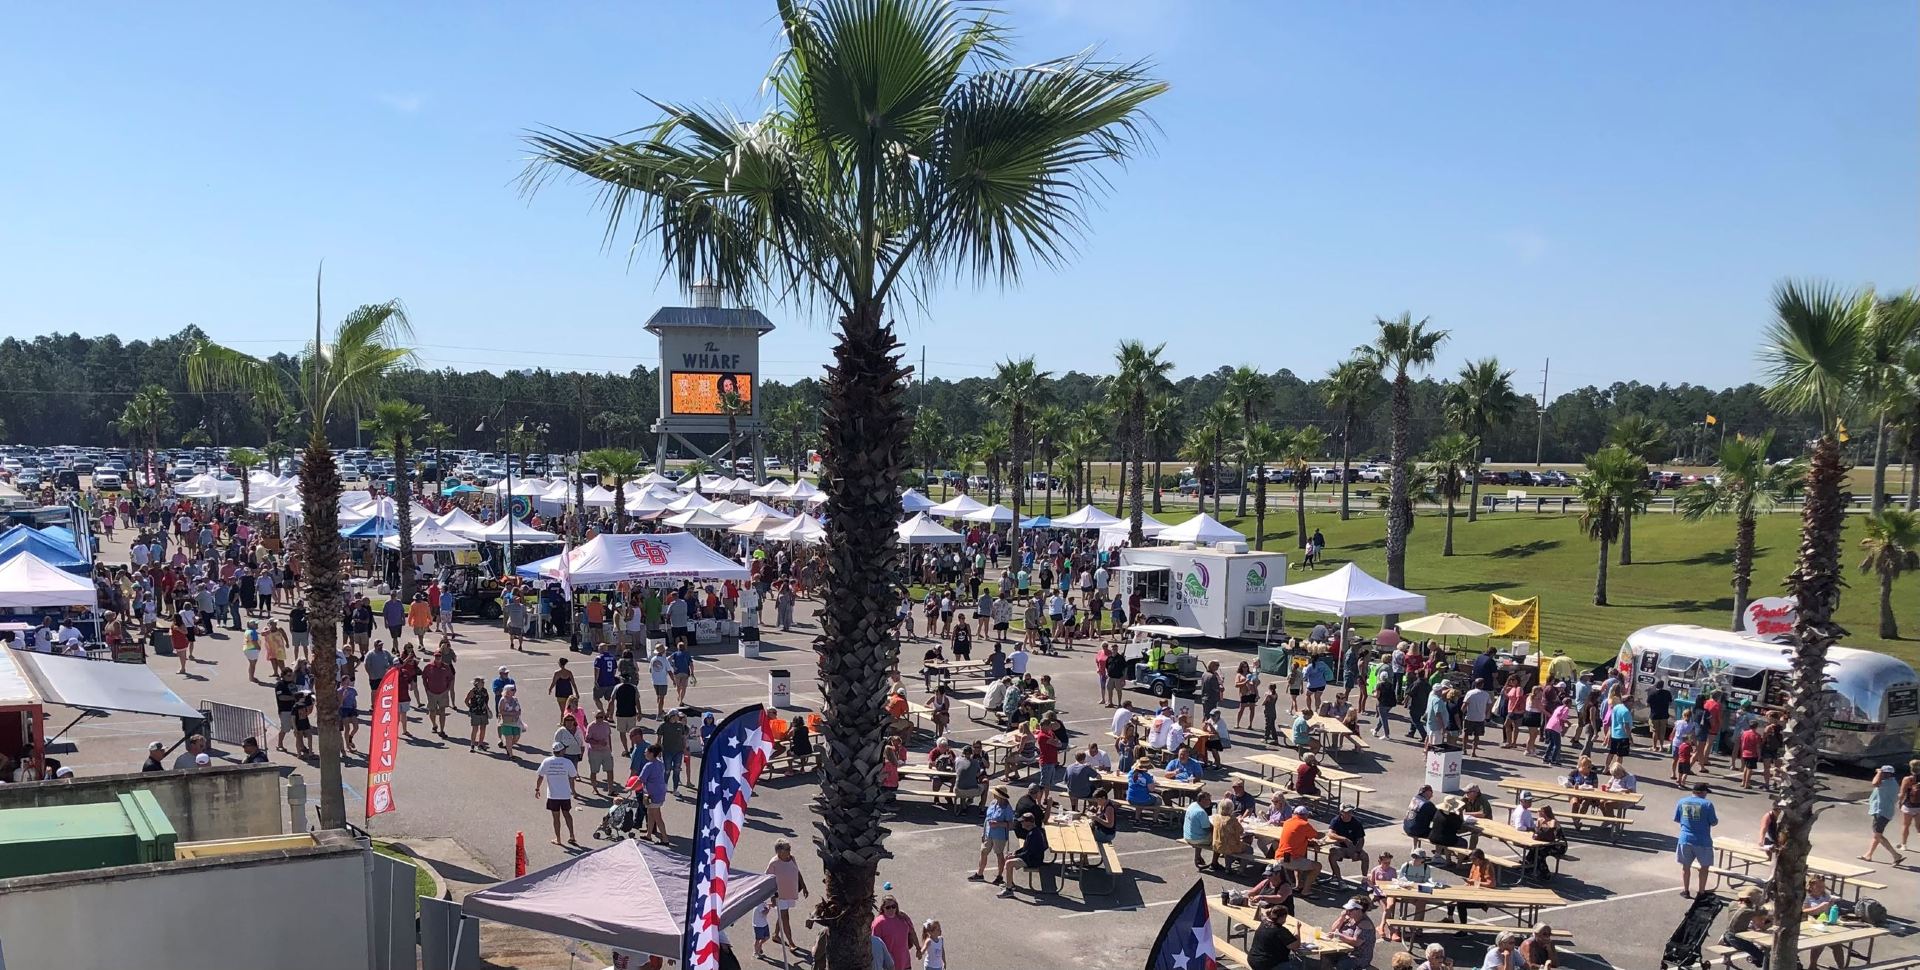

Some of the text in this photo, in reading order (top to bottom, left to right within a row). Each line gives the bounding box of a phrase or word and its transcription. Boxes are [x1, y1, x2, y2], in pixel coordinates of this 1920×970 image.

[704, 341, 721, 352] The
[682, 353, 740, 369] WHARF
[1183, 598, 1209, 606] BOWLZ
[1749, 604, 1790, 622] Frost
[606, 660, 613, 672] 9
